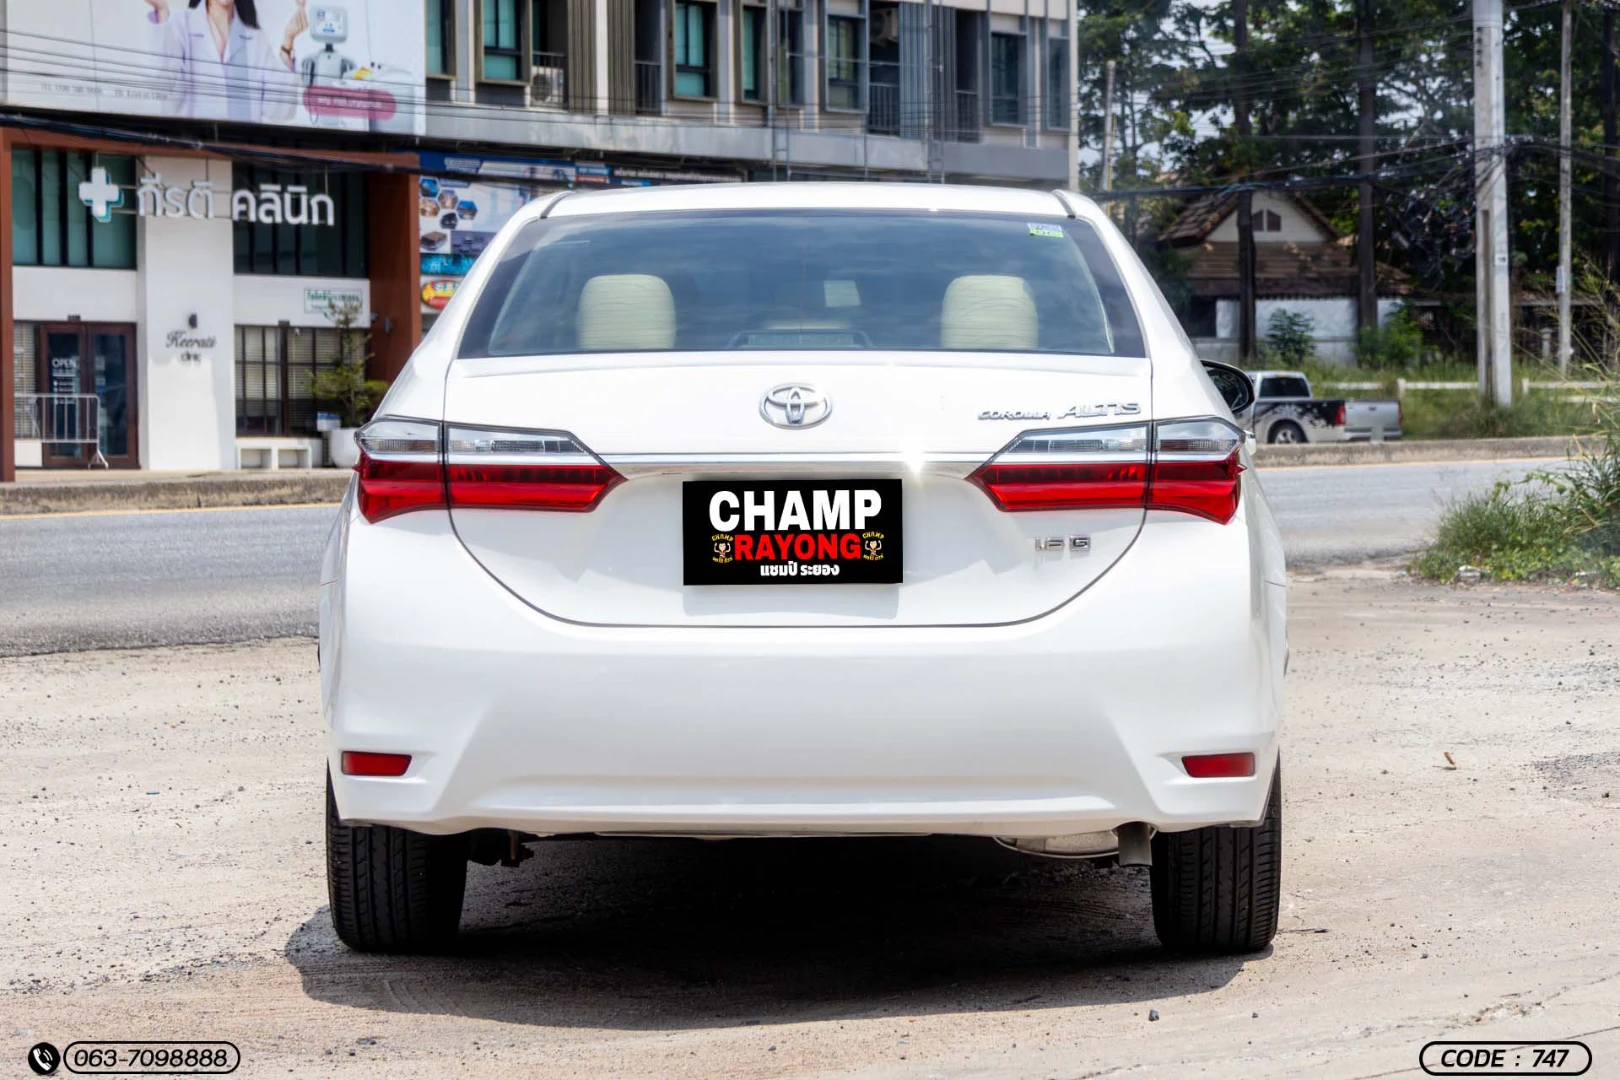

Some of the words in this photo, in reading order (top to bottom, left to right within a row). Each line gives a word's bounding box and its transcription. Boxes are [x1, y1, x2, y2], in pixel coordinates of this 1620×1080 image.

[137, 172, 214, 219] กีรติ
[231, 184, 335, 226] คลินิก
[52, 358, 77, 368] OPEN
[978, 410, 1051, 421] COROLLA
[1057, 402, 1141, 419] ALTIS
